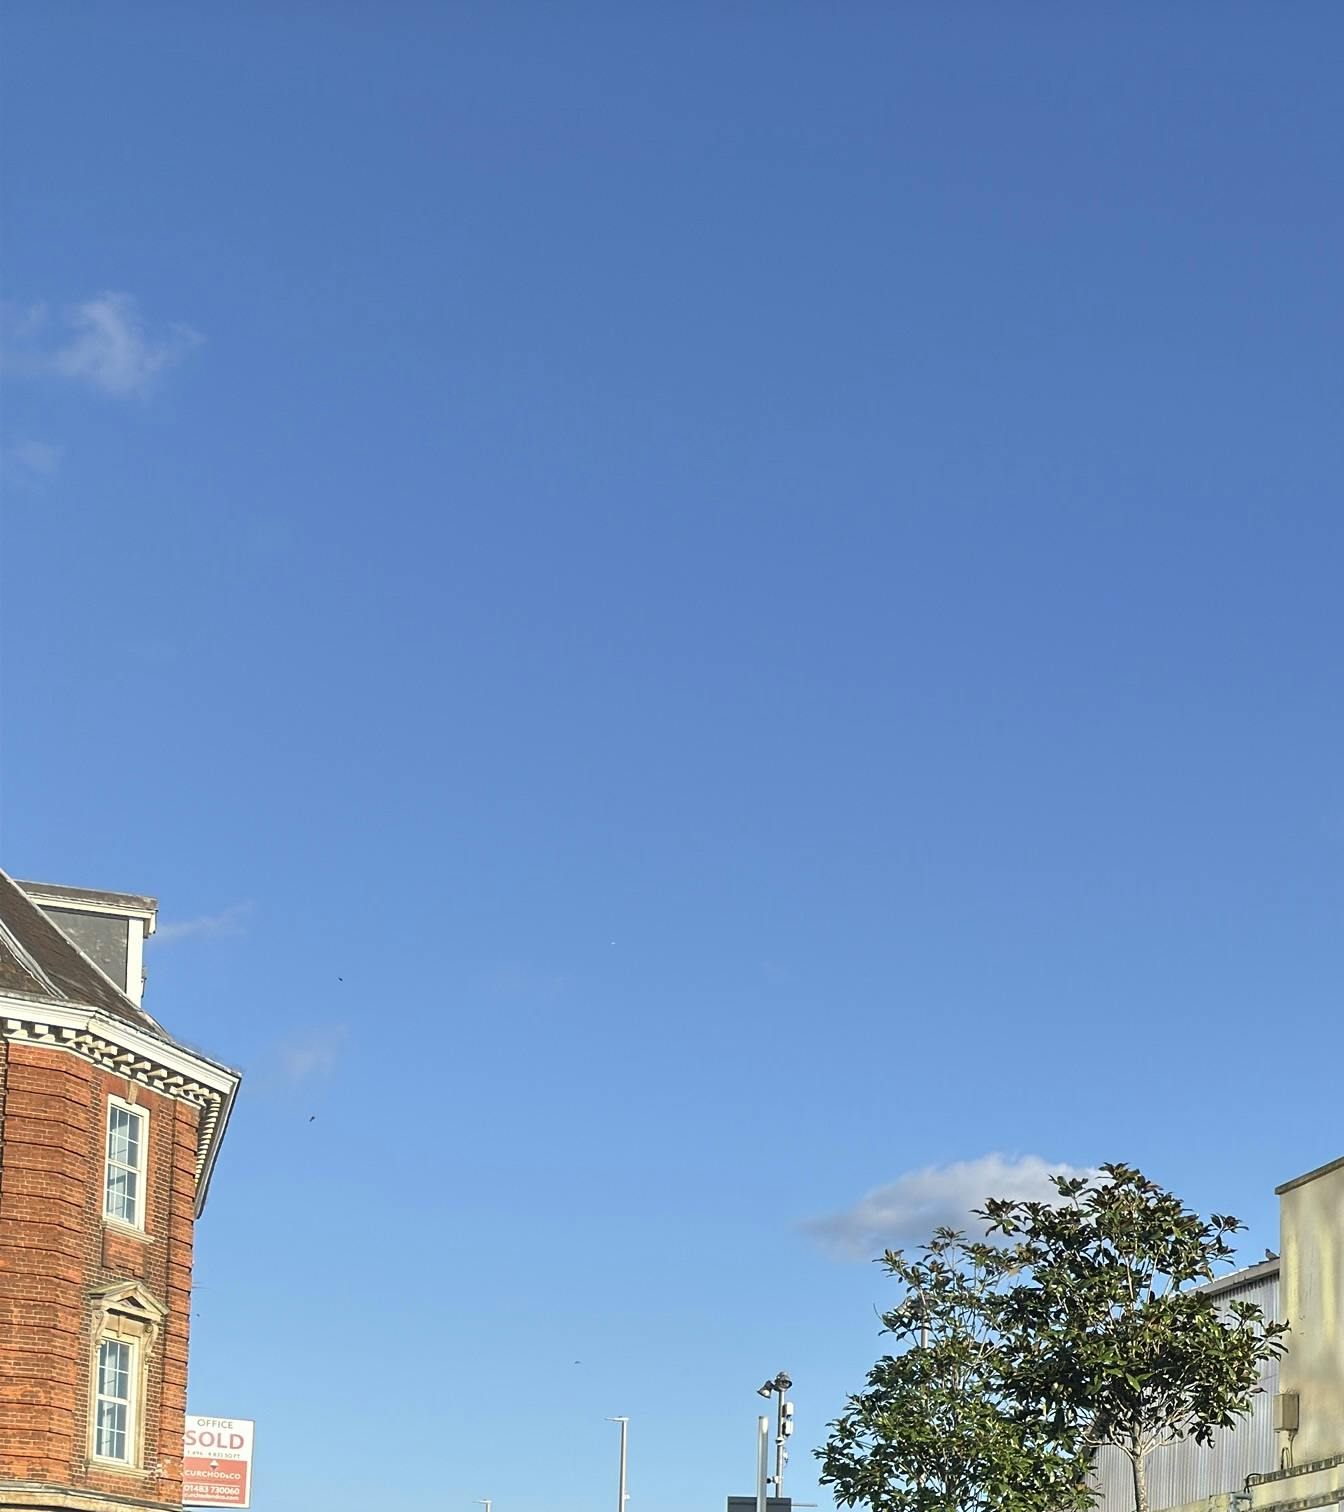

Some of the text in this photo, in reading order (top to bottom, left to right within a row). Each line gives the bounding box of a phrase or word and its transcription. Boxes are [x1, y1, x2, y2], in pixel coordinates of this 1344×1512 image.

[197, 1418, 233, 1429] OFFICE
[185, 1430, 244, 1449] SOLD
[184, 1484, 240, 1495] 01483 730060
